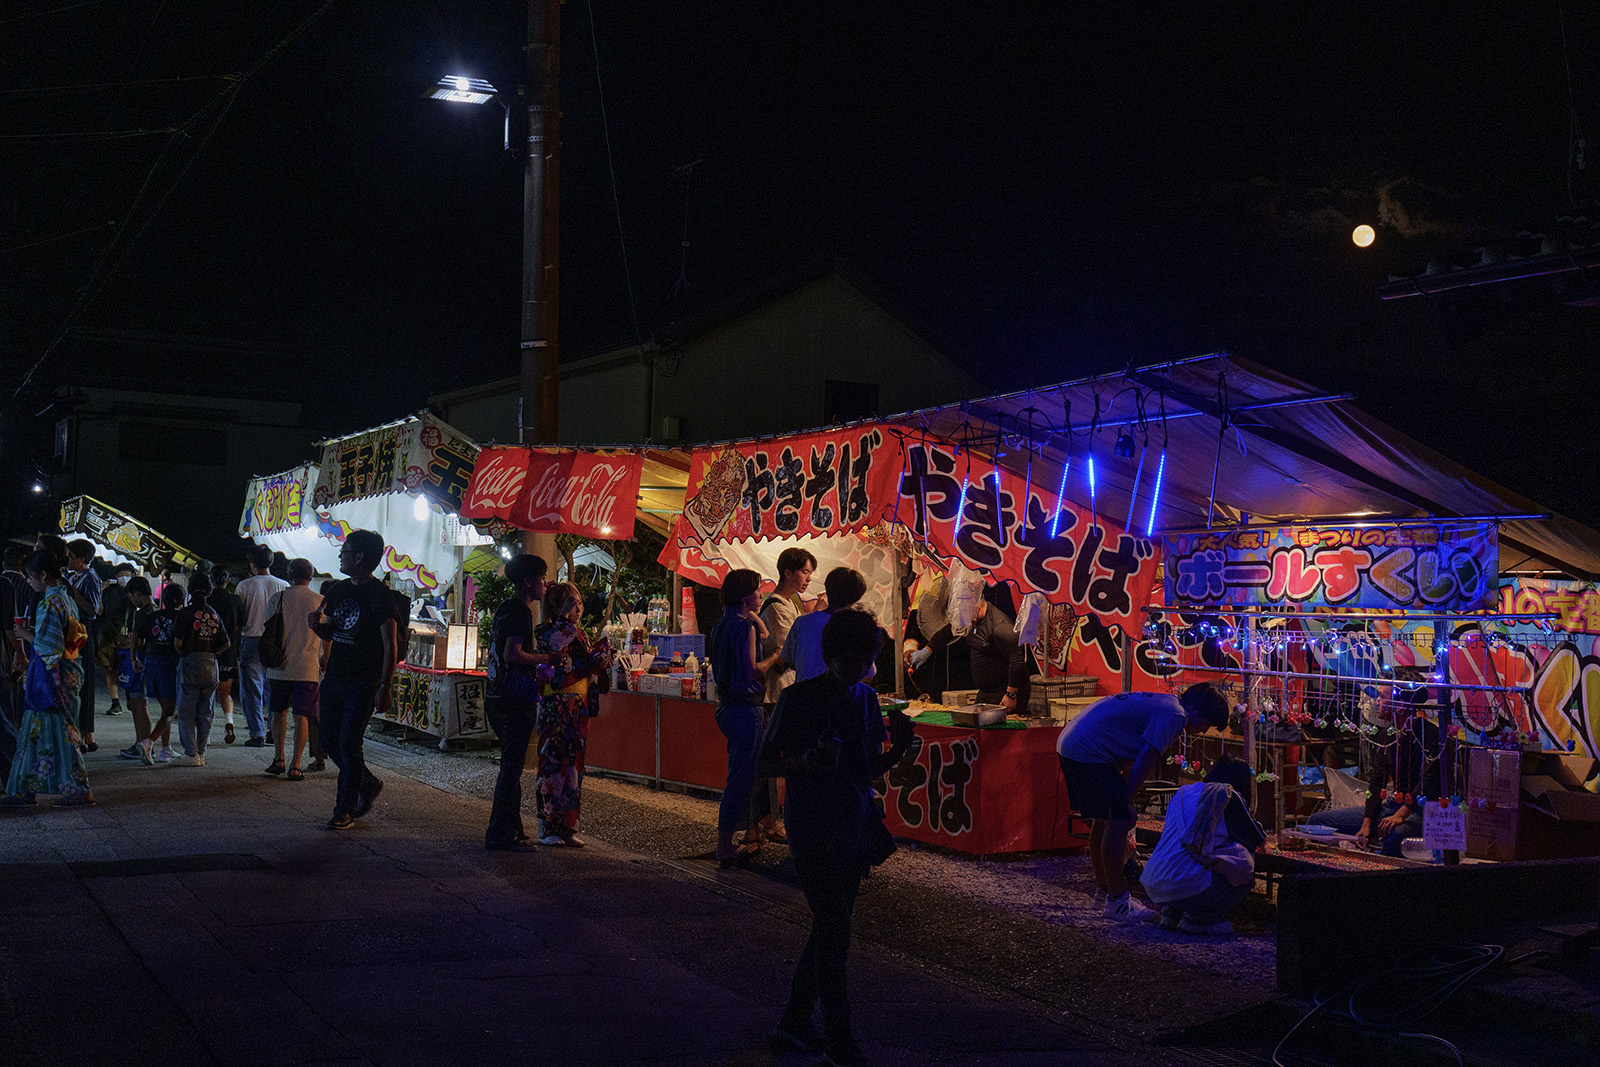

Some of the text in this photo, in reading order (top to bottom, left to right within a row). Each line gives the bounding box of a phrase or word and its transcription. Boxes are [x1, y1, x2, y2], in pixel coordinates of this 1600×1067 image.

[528, 462, 633, 530] Coca-Cola
[741, 427, 883, 537] やきそば
[897, 443, 1153, 617] やきそば
[1175, 546, 1486, 606] ボールすくい
[873, 734, 979, 836] そば
